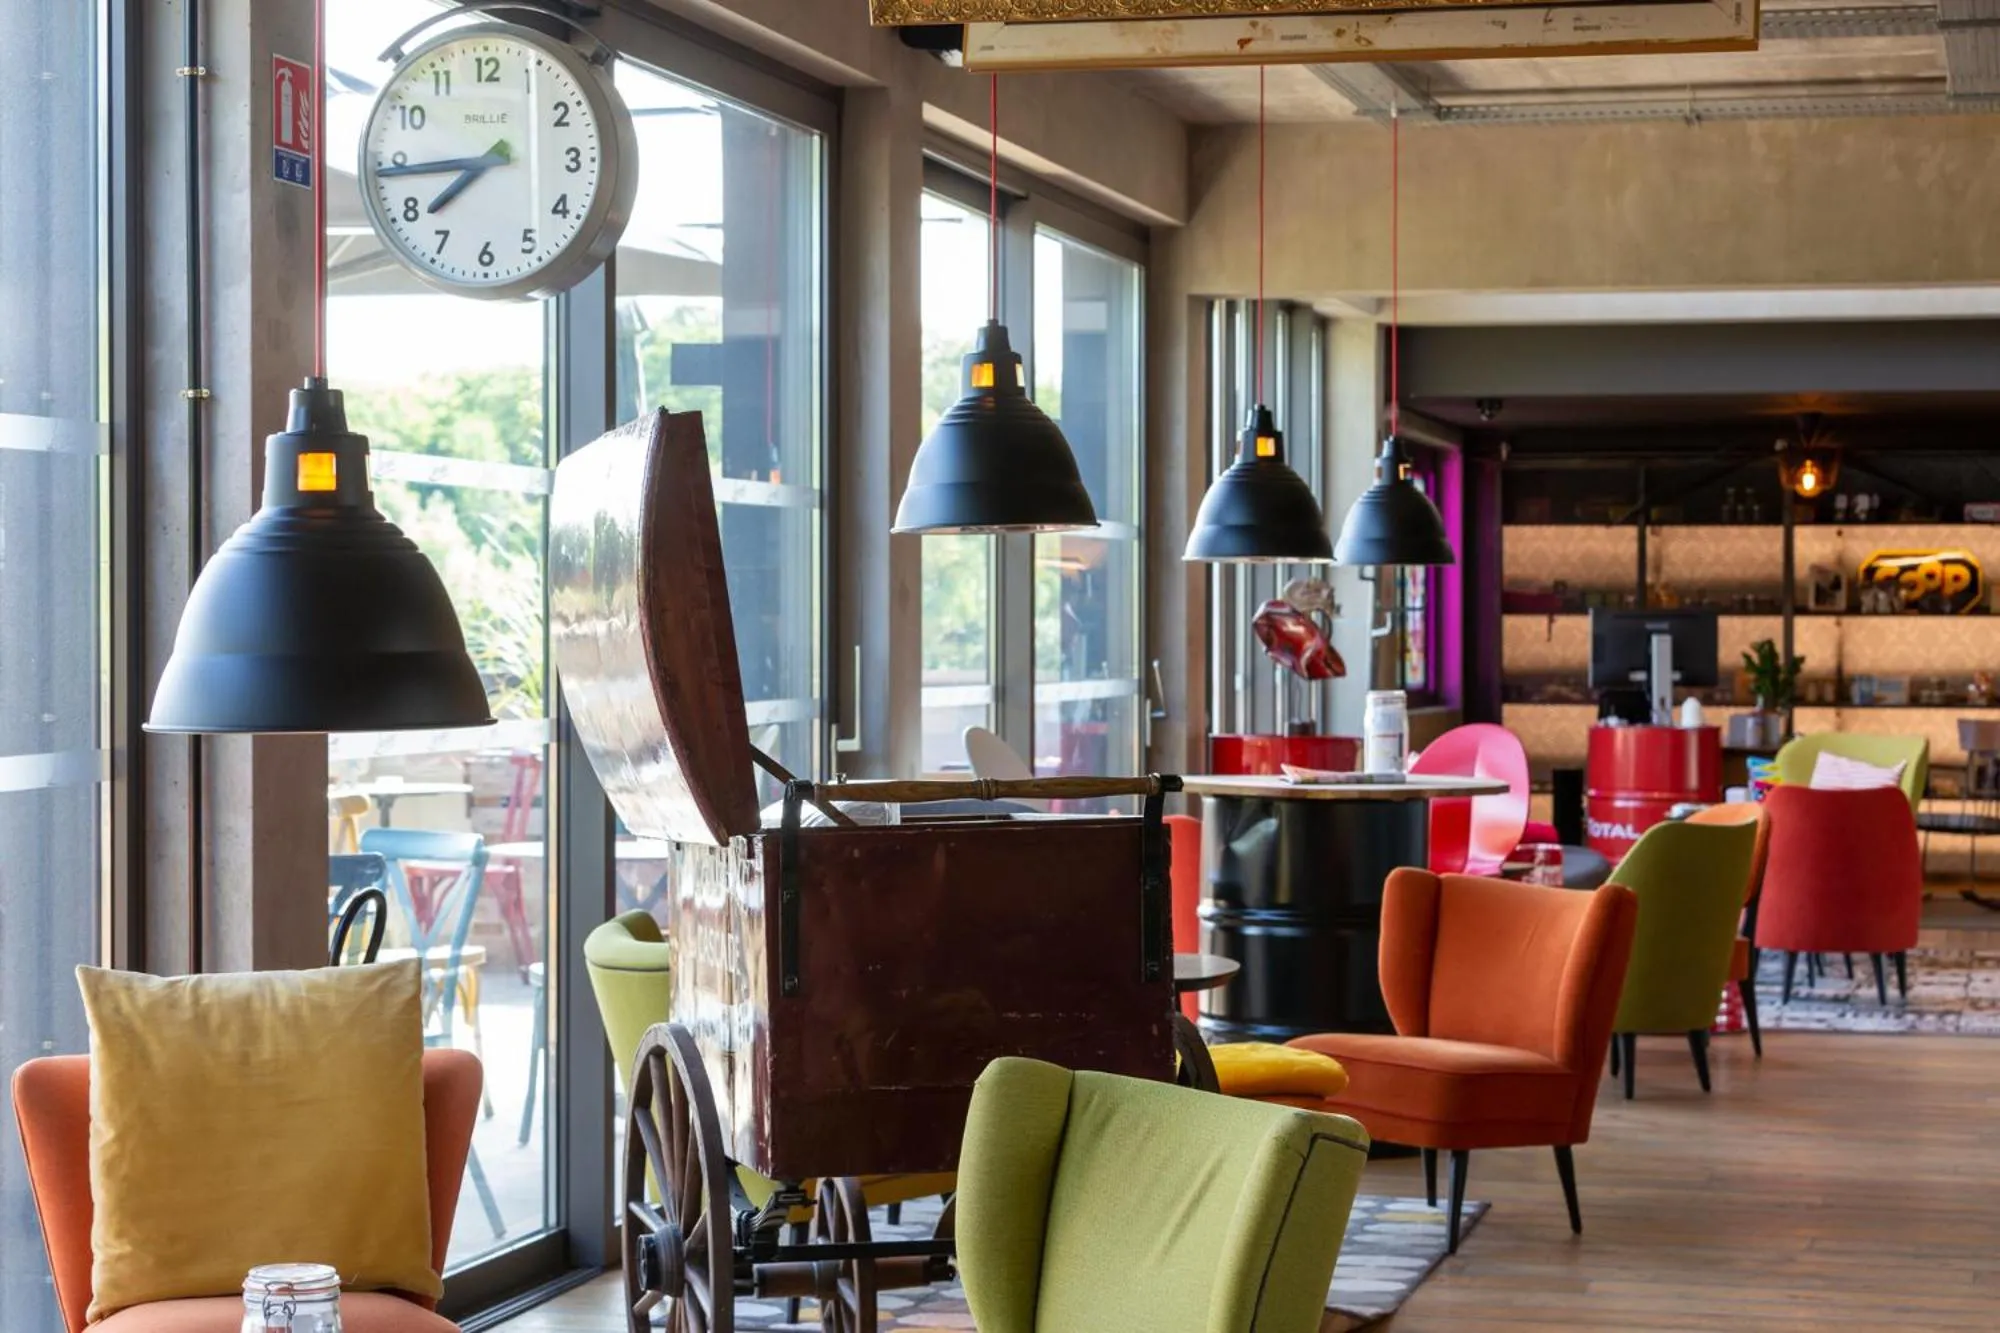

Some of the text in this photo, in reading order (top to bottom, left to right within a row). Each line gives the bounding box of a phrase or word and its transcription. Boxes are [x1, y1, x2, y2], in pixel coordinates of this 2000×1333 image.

[475, 57, 500, 82] 12
[525, 68, 531, 94] 1
[433, 70, 451, 96] 11
[399, 105, 426, 130] 10
[553, 101, 570, 127] 2
[565, 147, 581, 173] 3
[403, 197, 419, 222] 8
[551, 194, 570, 219] 4
[434, 230, 450, 255] 7
[521, 229, 537, 254] 5
[478, 242, 495, 267] 6
